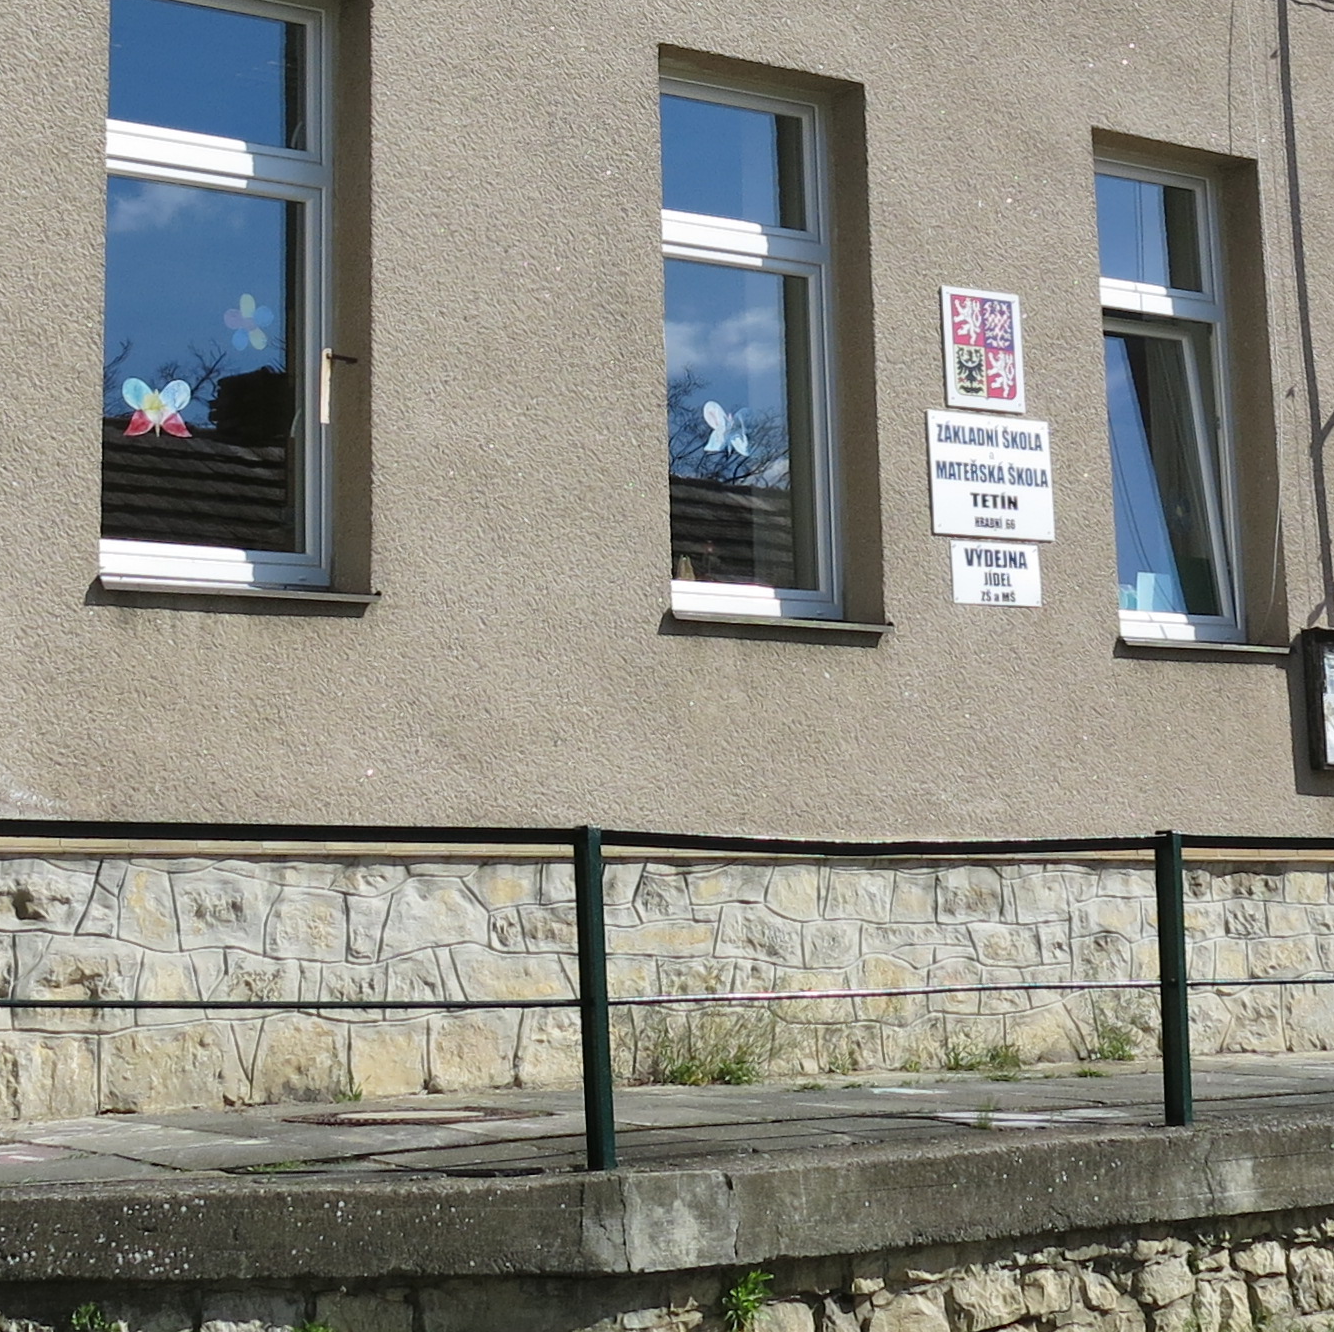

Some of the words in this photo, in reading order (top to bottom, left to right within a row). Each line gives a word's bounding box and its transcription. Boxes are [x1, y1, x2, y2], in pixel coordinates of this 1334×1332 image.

[936, 421, 999, 448] ZÁKLADNÍ
[1002, 425, 1044, 451] ŠKOLA
[989, 451, 995, 460] a
[935, 459, 1006, 485] MATEŘSKÁ
[1008, 462, 1049, 488] ŠKOLA
[970, 492, 1019, 510] TETÍN
[964, 544, 1028, 570] VÝDEJNA
[983, 569, 1012, 587] JÍDEL
[981, 589, 992, 602] ZŠ
[994, 593, 1000, 602] a
[1001, 591, 1016, 603] MŠ
